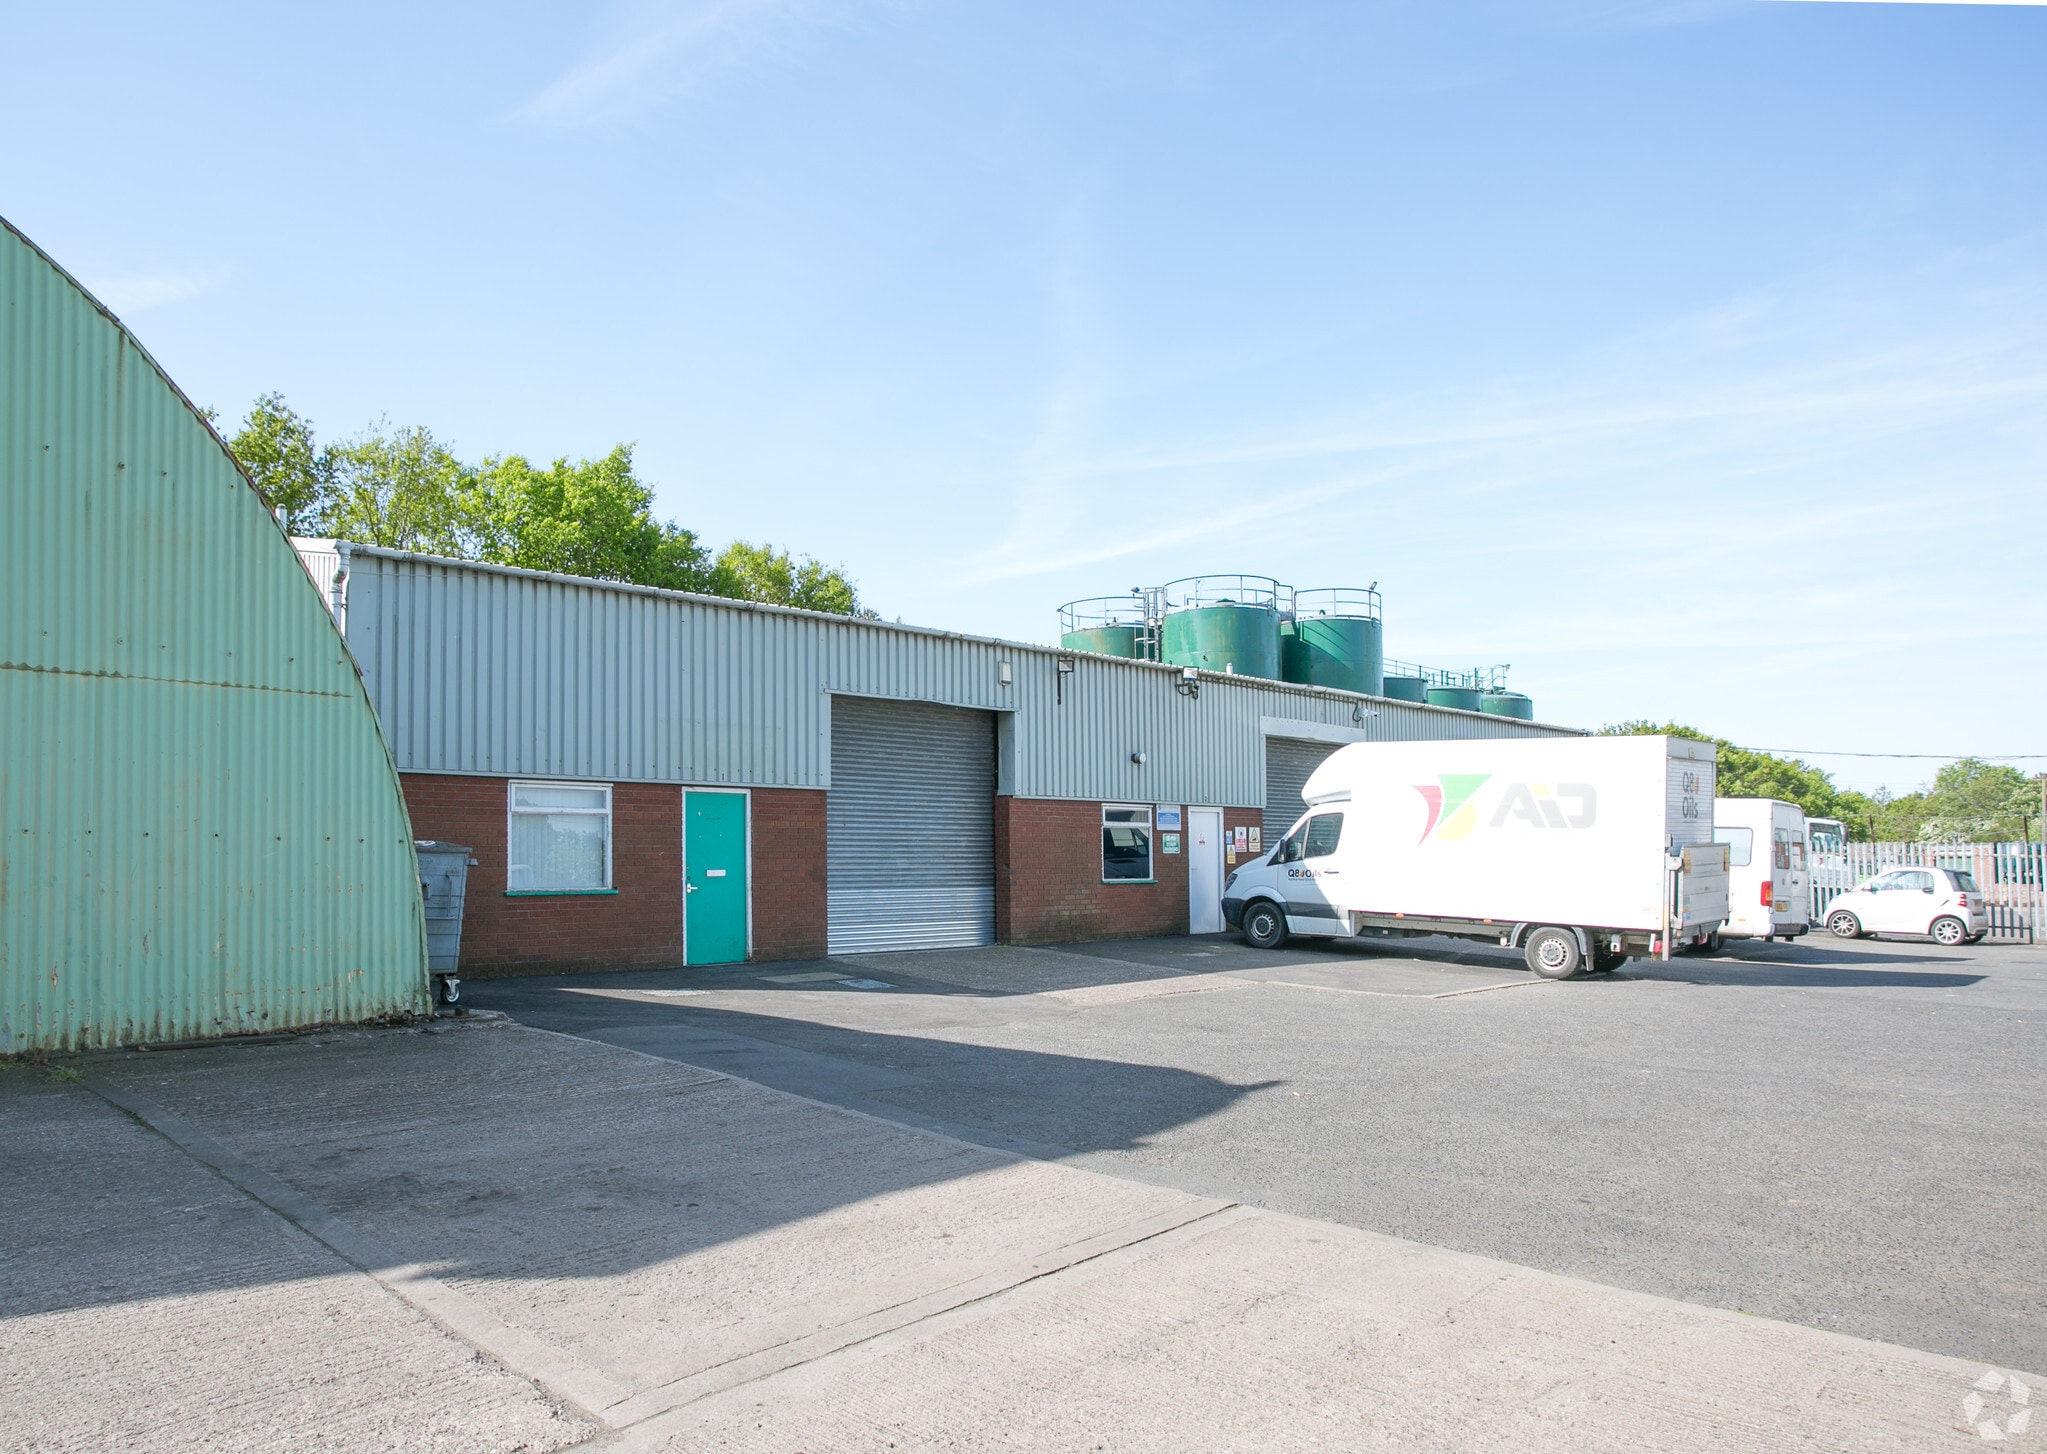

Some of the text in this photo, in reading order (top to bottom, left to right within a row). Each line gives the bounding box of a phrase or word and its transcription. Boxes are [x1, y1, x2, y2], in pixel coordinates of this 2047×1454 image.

[1682, 771, 1694, 794] Q8
[1682, 796, 1699, 818] Oils
[1288, 869, 1300, 877] Q8
